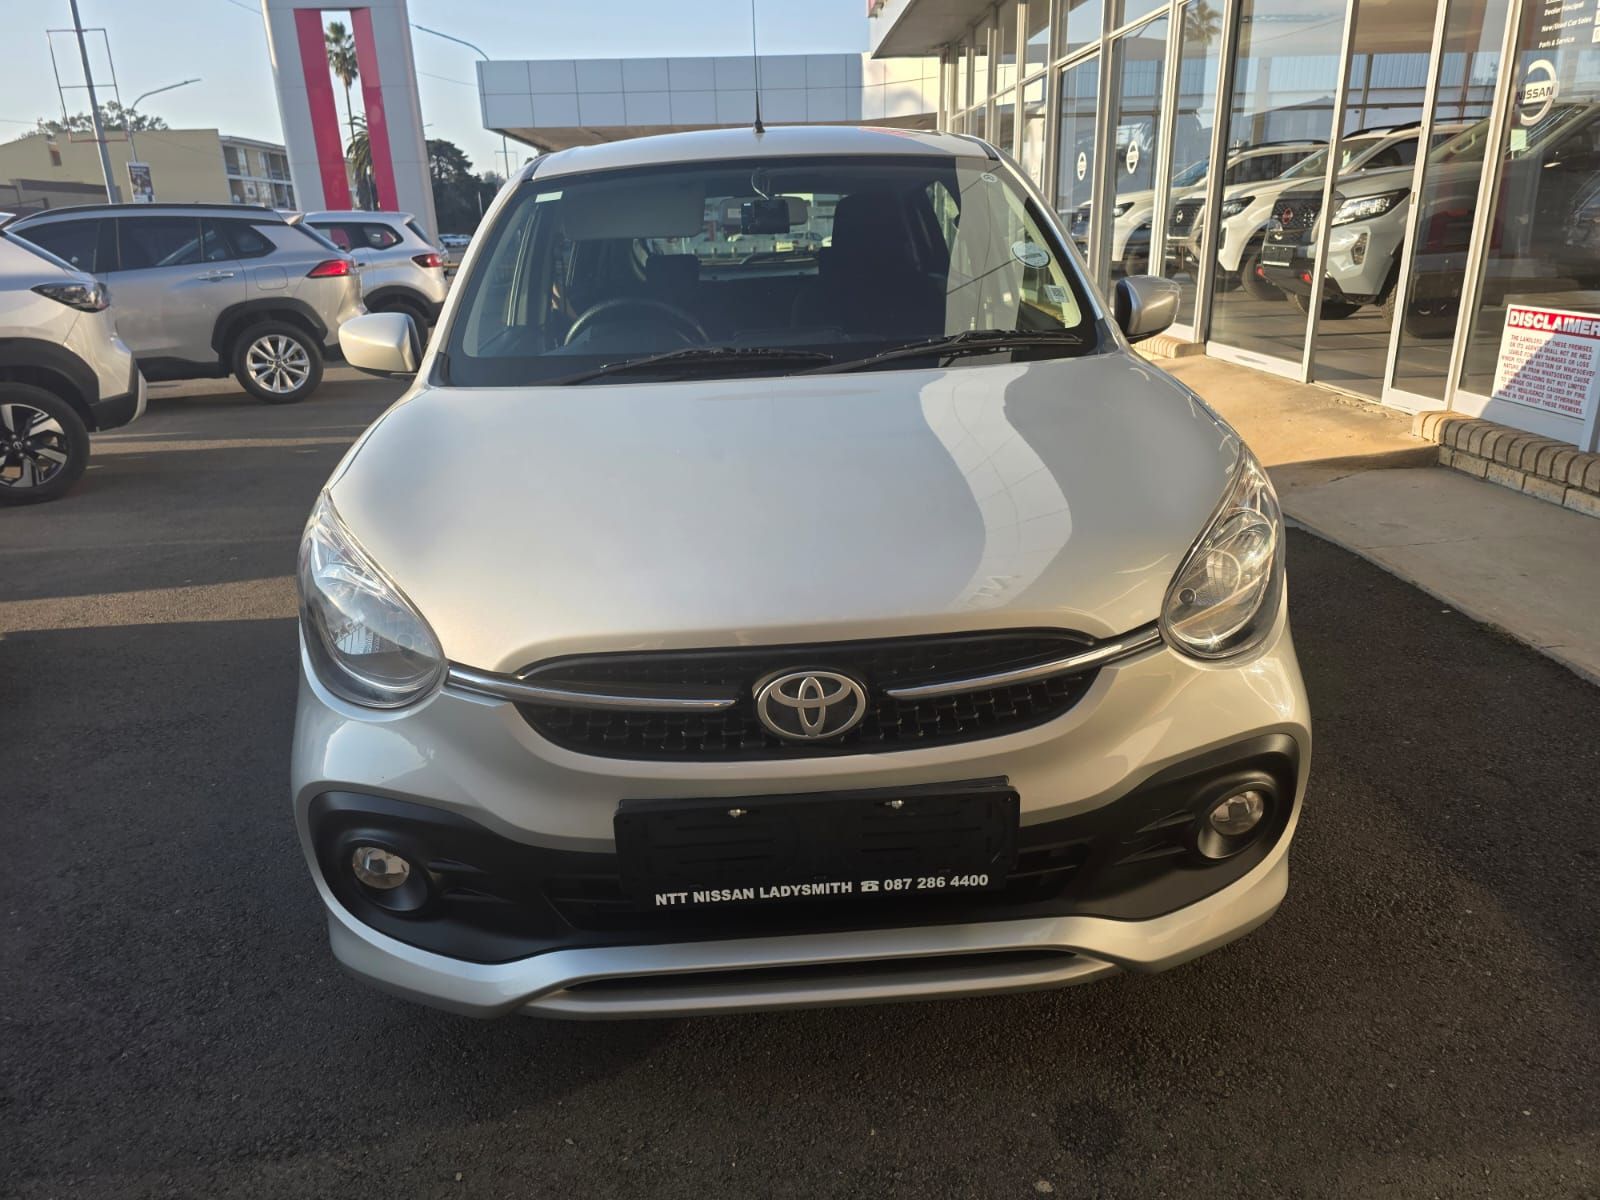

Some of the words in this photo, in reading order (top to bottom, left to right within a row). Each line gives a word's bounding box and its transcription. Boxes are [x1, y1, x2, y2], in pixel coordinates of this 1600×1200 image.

[1519, 86, 1554, 100] NISSAN
[1509, 310, 1600, 336] DISCLAIMER
[655, 892, 688, 906] NTT
[693, 888, 754, 904] NISSAN
[760, 882, 852, 899] LADYSMITH
[884, 878, 913, 891] 087
[917, 876, 946, 889] 286
[950, 874, 988, 887] 4400
